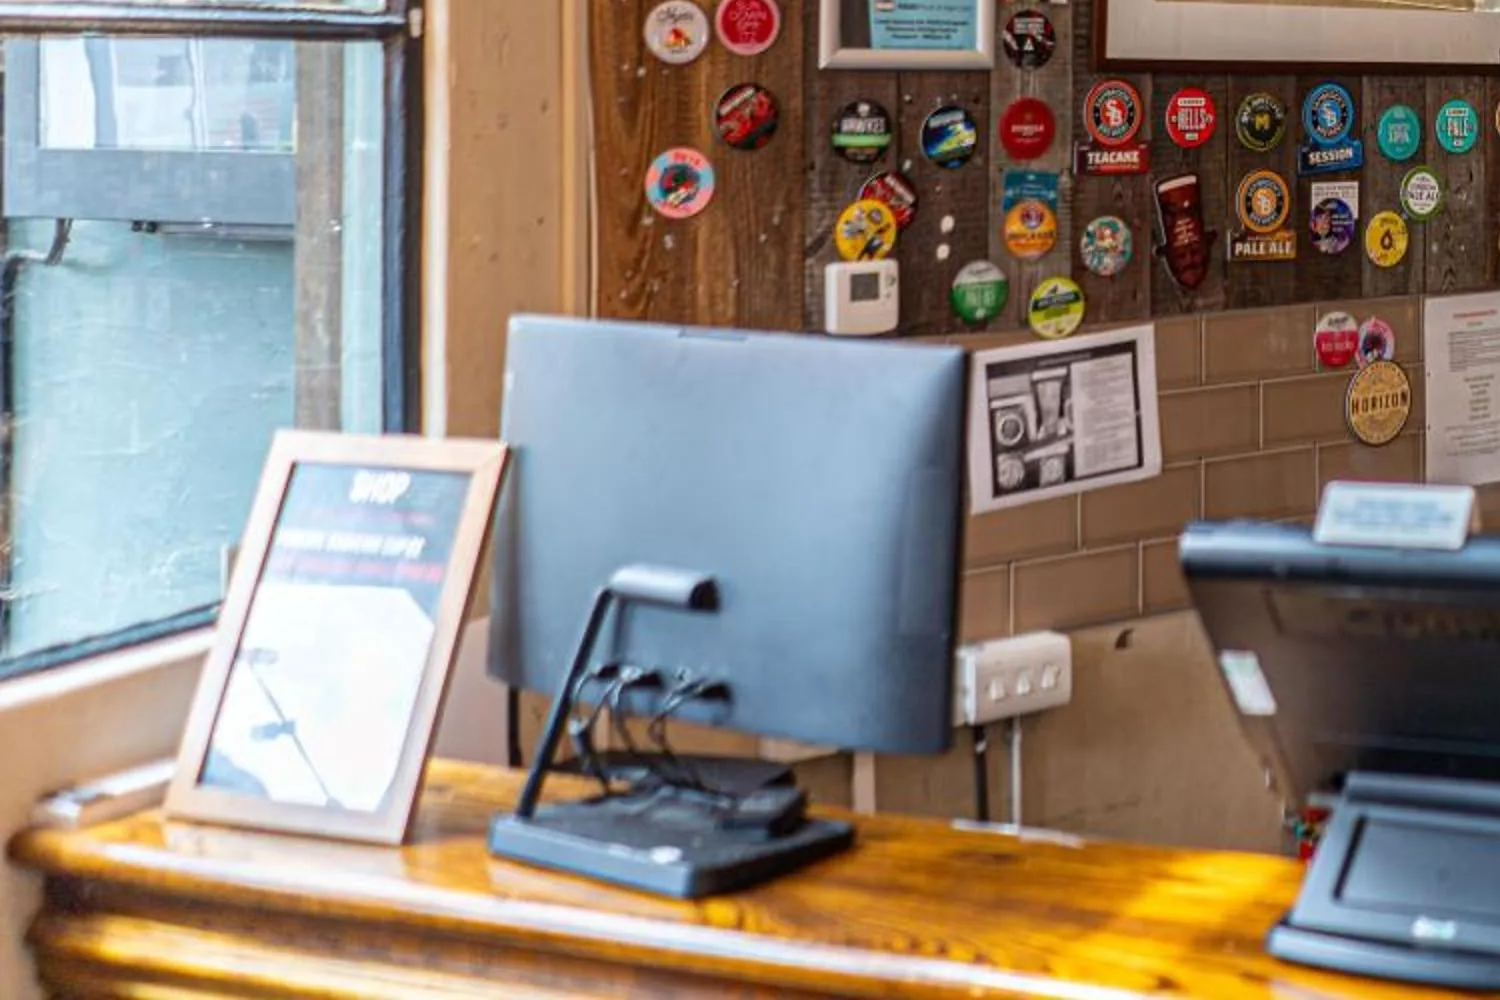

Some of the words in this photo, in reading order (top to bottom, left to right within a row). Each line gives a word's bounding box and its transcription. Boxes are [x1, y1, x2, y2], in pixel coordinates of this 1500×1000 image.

[1308, 148, 1353, 166] SESSION
[1235, 242, 1265, 256] PALE
[1268, 240, 1292, 254] ALE
[1351, 390, 1409, 415] HORIZON
